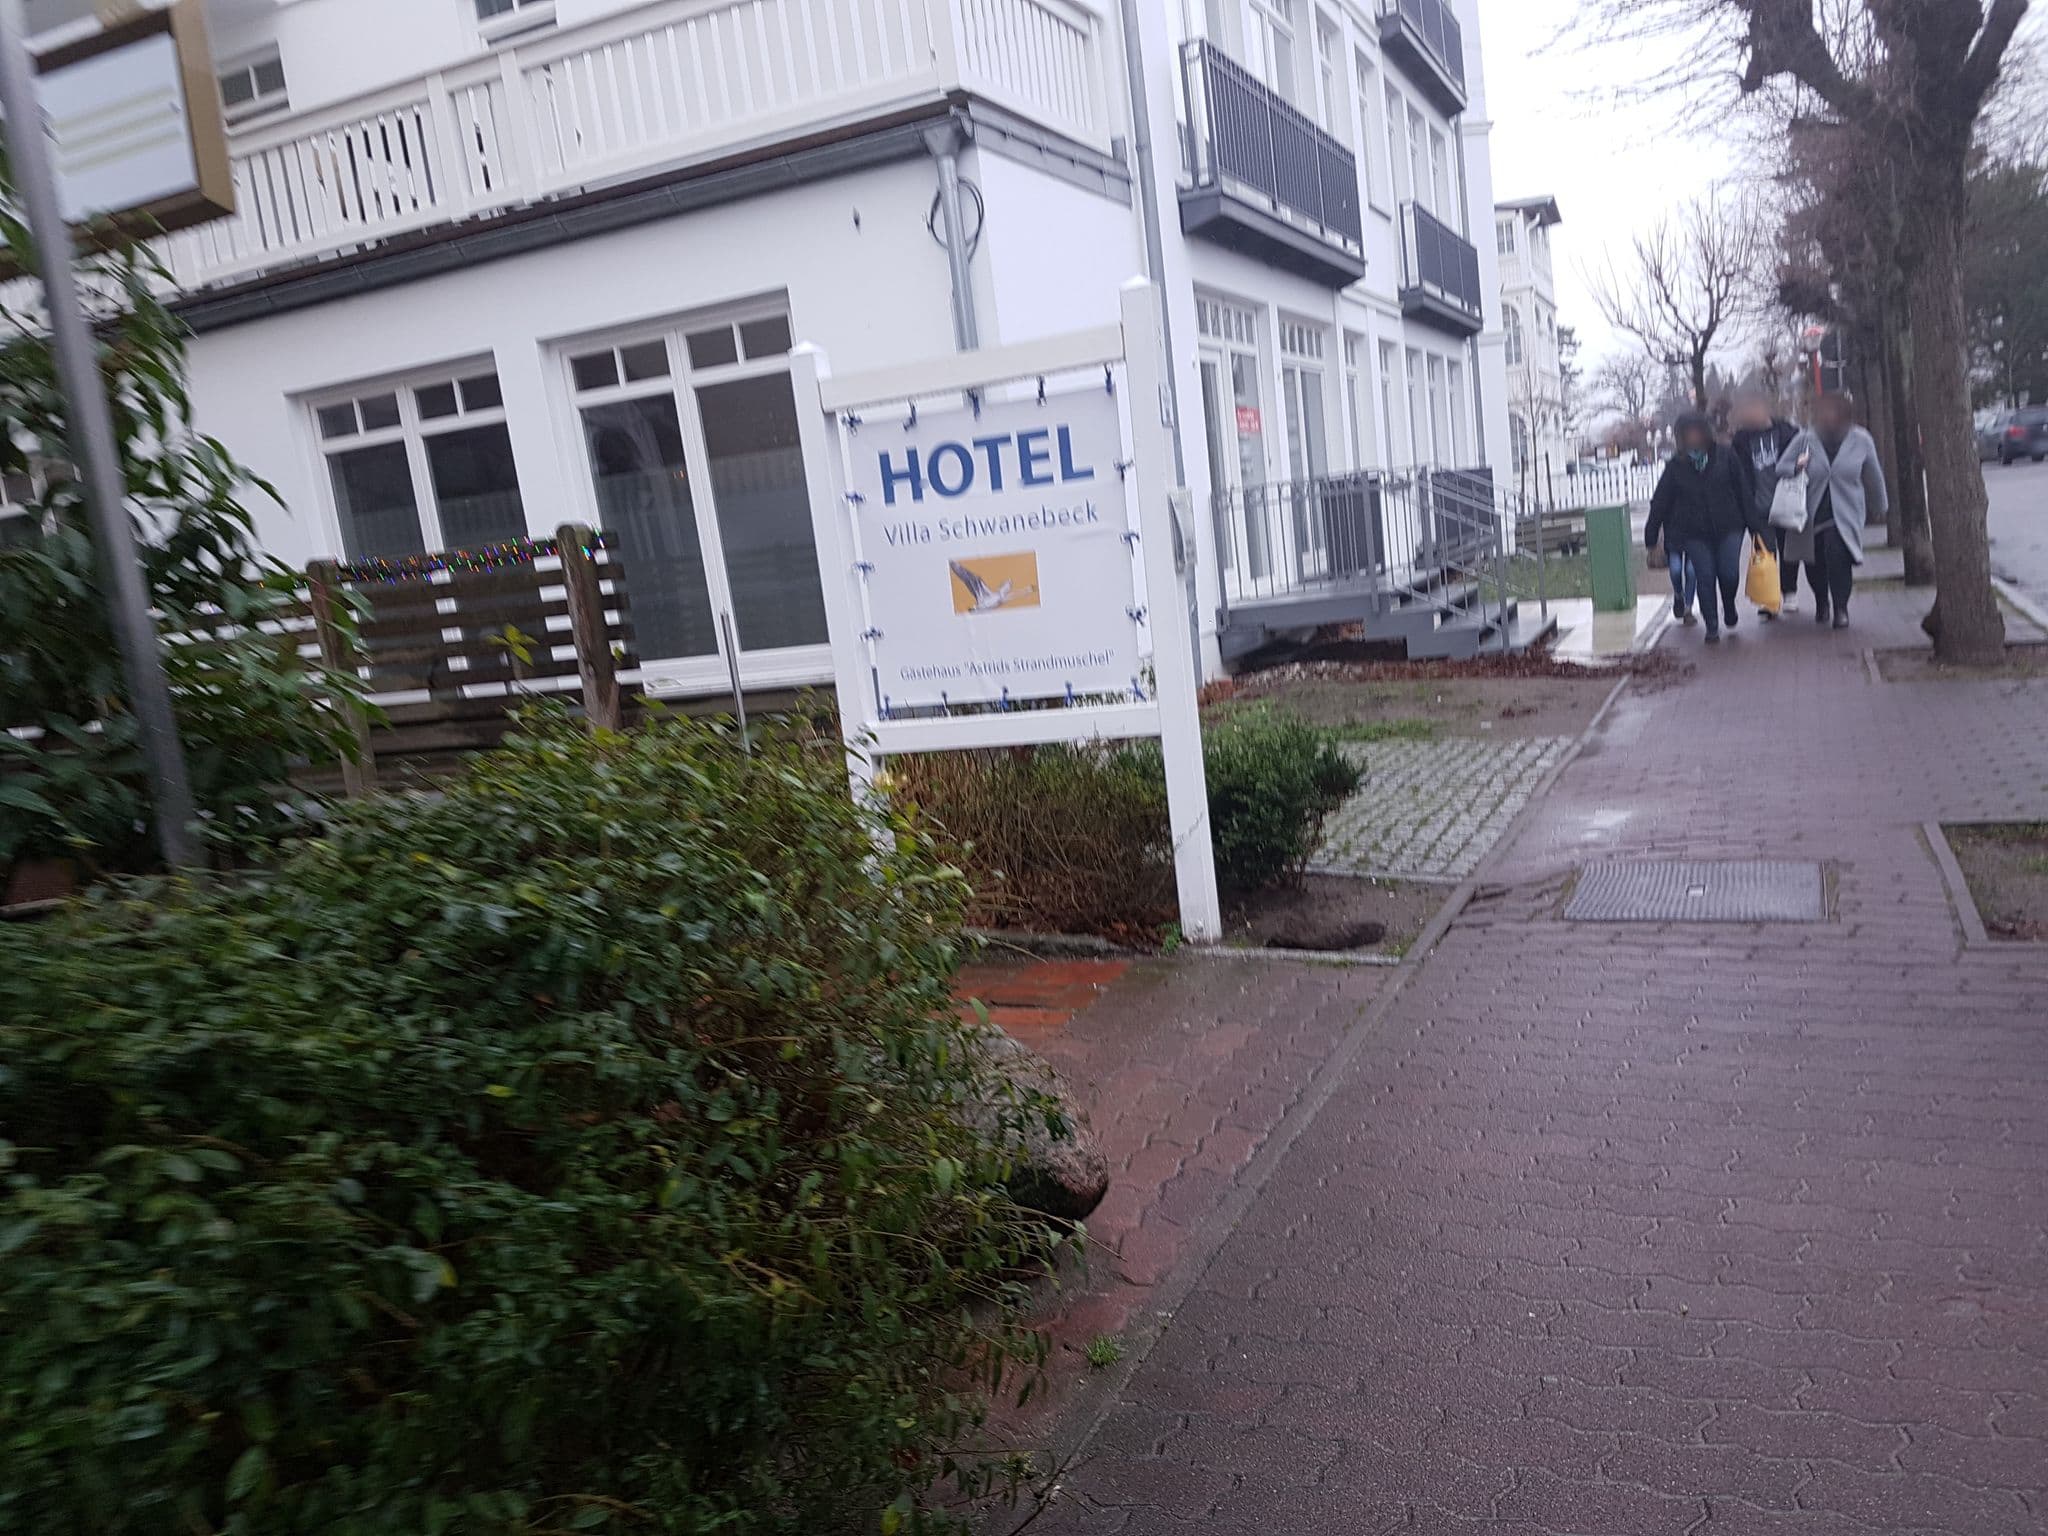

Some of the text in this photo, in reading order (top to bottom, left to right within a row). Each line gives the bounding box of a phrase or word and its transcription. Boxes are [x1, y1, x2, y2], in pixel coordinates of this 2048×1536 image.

[878, 423, 1094, 504] HOTEL
[883, 499, 1099, 547] Villa Schwanebeck
[900, 663, 961, 681] Gästehaus
